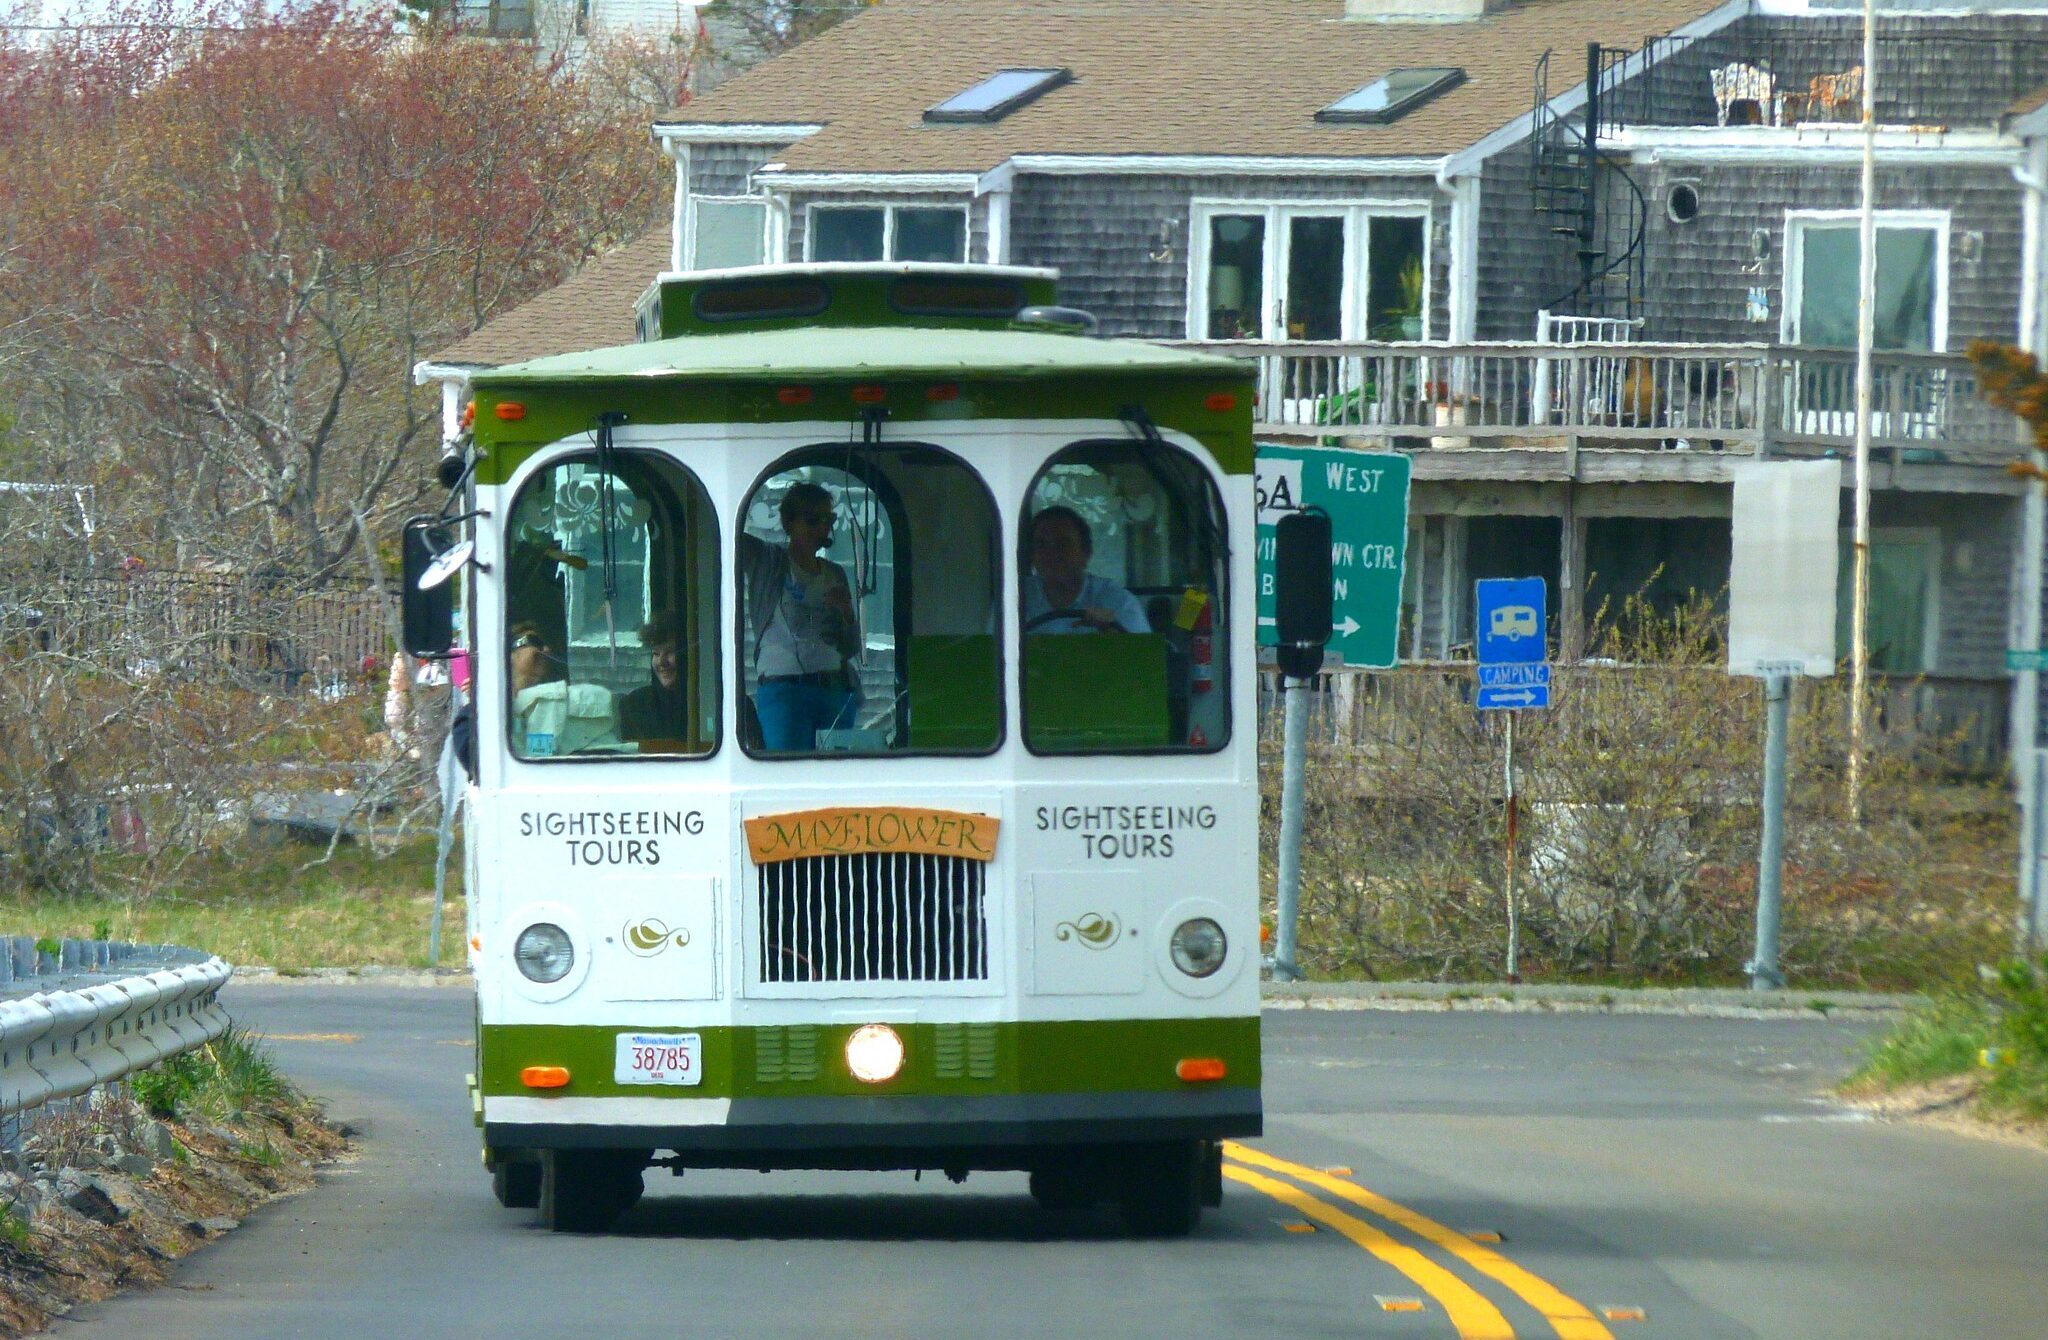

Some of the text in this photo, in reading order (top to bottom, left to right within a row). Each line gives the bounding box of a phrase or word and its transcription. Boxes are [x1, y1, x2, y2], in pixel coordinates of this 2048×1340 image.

[1326, 462, 1384, 493] WEST
[1485, 665, 1544, 685] CAMPING
[520, 811, 704, 836] SIGHTSEEING
[1036, 805, 1217, 831] SIGHTSEEING
[760, 813, 990, 853] MAYFLOWER
[566, 840, 660, 866] TOURS
[1082, 834, 1174, 859] TOURS
[632, 1047, 690, 1070] 38785
